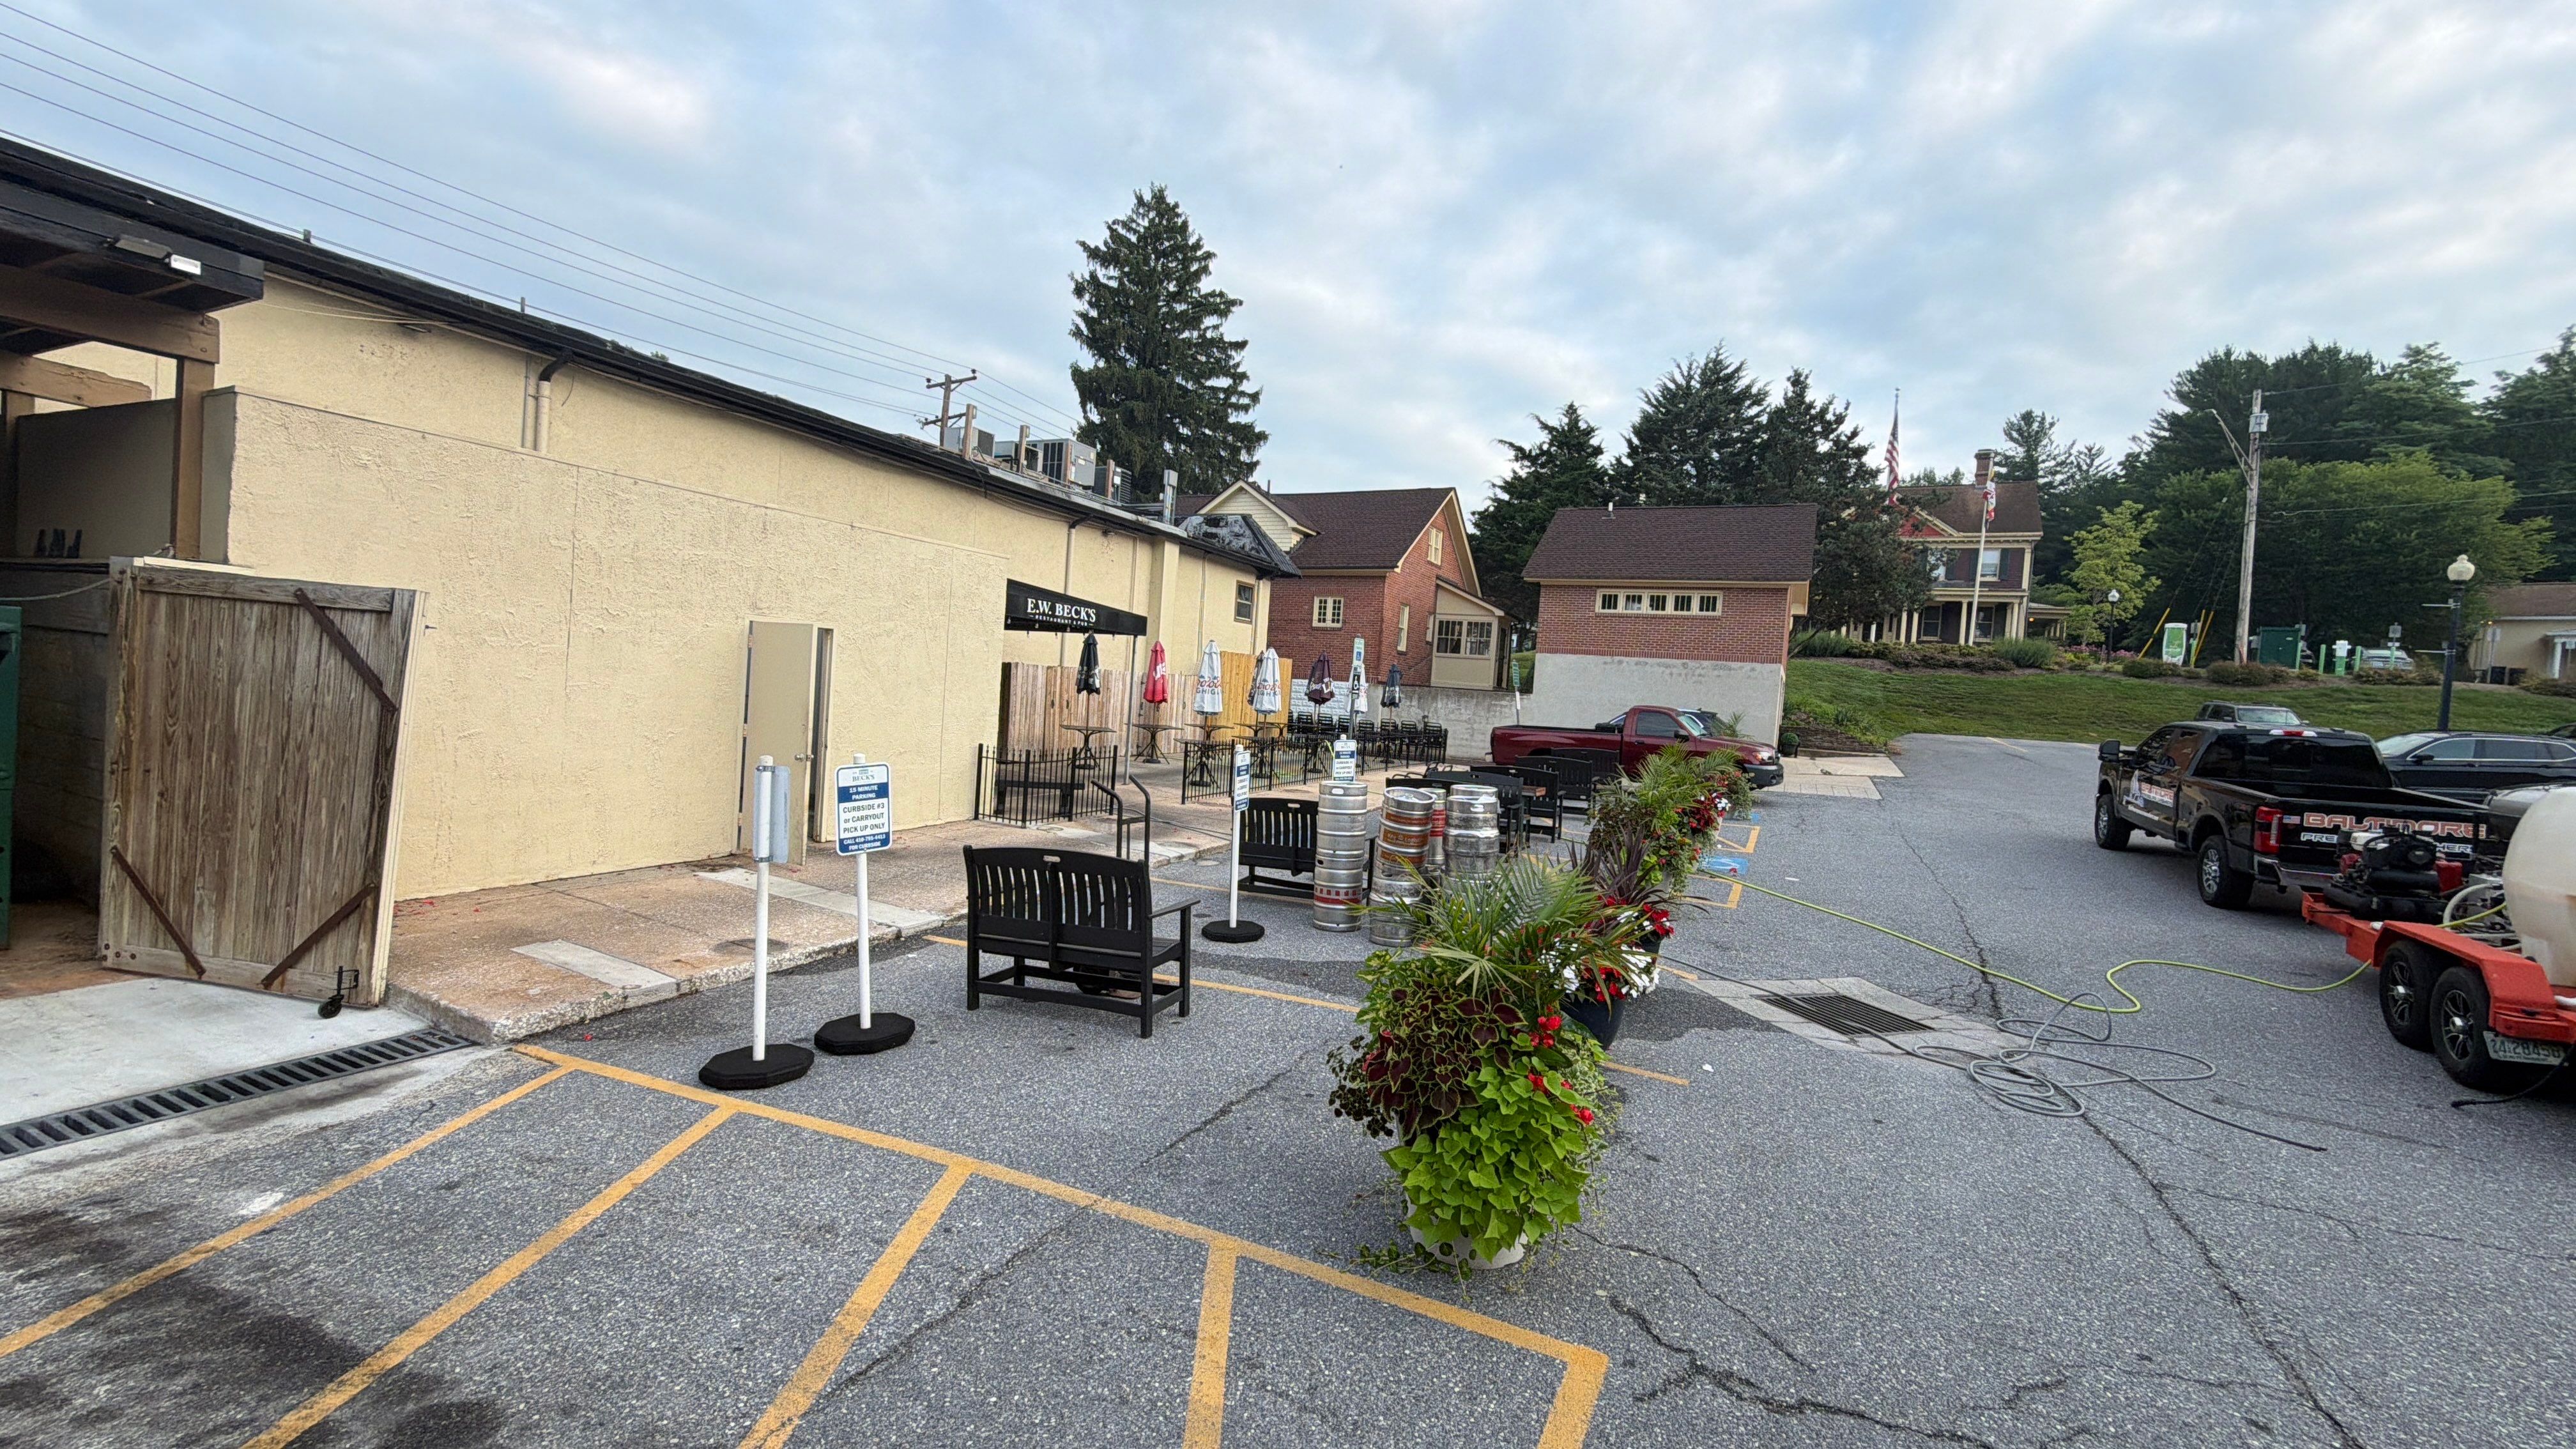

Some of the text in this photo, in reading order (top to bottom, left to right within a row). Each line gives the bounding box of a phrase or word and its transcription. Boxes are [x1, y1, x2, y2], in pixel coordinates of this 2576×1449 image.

[1027, 598, 1096, 622] E.W. BECK'S
[843, 803, 875, 813] CURBSIDE
[852, 812, 884, 822] CARRYOUT
[870, 822, 885, 831] ONLY
